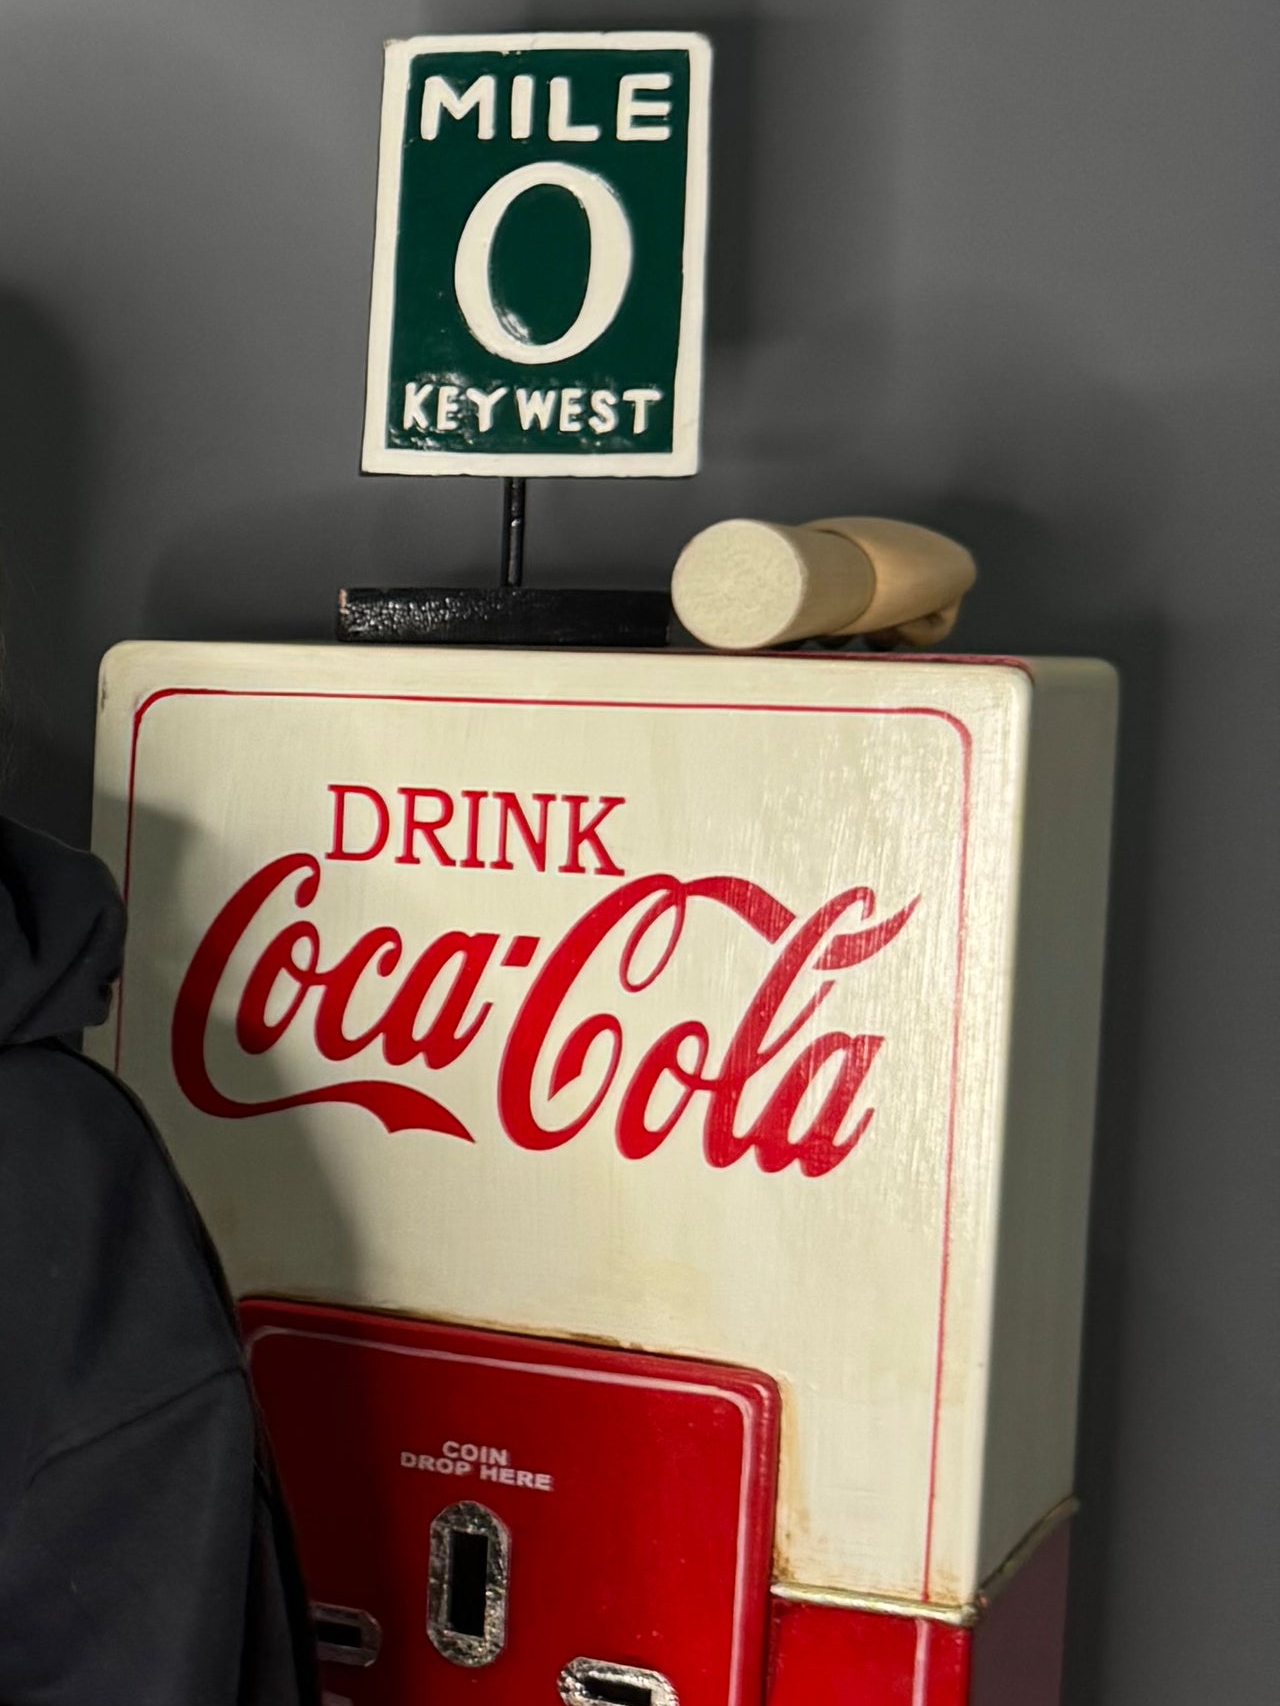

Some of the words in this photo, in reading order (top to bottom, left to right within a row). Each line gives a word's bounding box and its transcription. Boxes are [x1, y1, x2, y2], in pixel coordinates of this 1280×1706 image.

[420, 72, 673, 142] MILE
[402, 381, 509, 433] KEY
[514, 387, 662, 435] WEST
[324, 783, 628, 877] DRINK
[170, 851, 923, 1180] Coca-Cola
[400, 1451, 472, 1476] DROP
[479, 1464, 554, 1492] HERE
[442, 1440, 509, 1466] COIN
